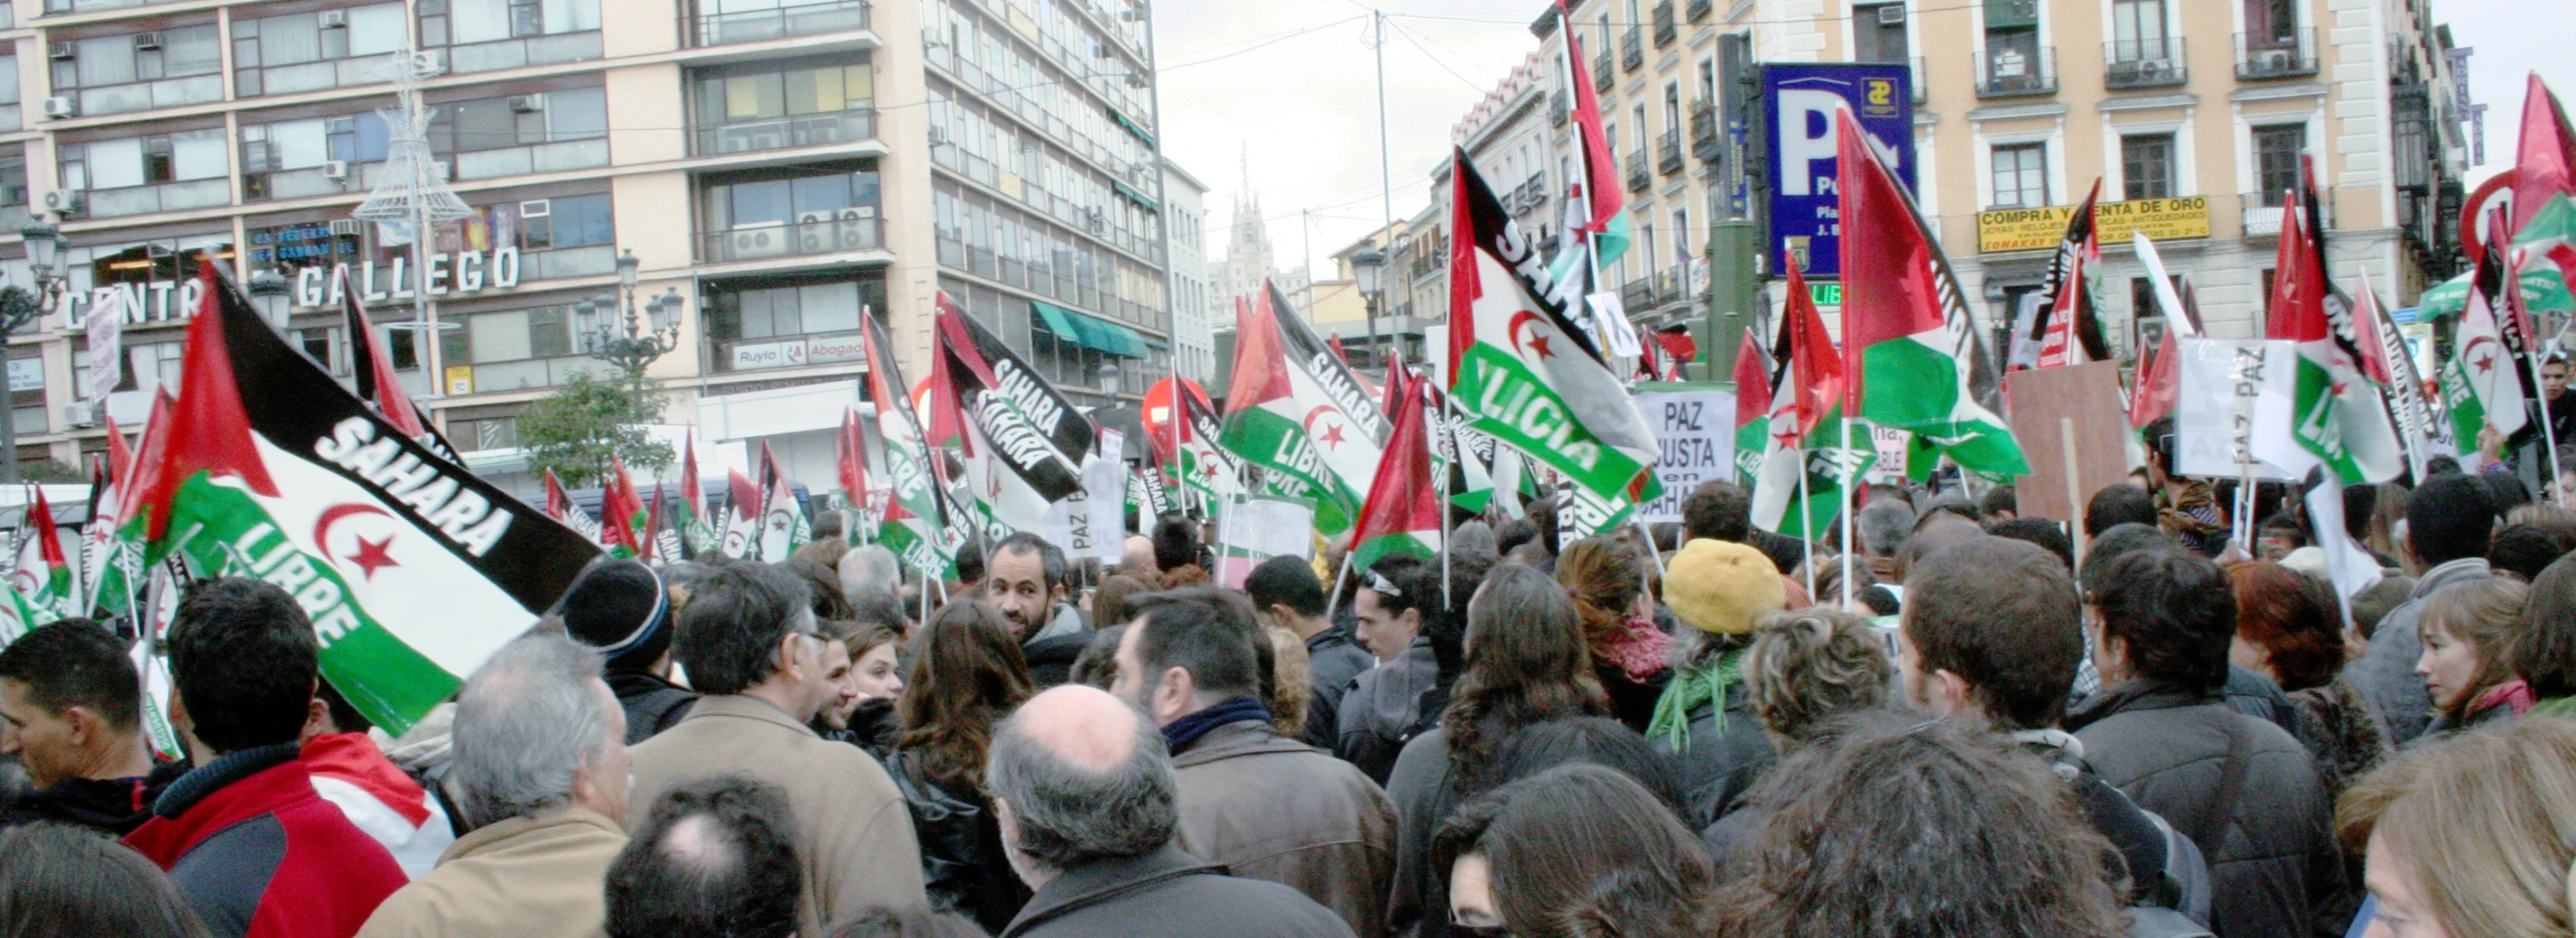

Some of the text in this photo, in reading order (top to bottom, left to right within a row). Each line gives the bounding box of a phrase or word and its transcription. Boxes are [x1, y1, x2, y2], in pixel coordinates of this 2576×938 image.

[1817, 207, 1839, 219] Pla
[1982, 197, 2205, 225] COMPRA Y ENTA DE ORO
[1984, 238, 2046, 250] SONAKAY
[65, 245, 519, 330] CNTR GALLEGO
[1812, 285, 1842, 305] LIB
[811, 343, 865, 357] Abogad
[994, 358, 1064, 437] SAHARA
[1309, 352, 1382, 440] SAHARA
[1476, 357, 1600, 471] LICIA
[1665, 401, 1703, 431] PAZ
[975, 389, 1053, 471] SAHARA
[1275, 428, 1335, 495] LIBRE
[1664, 472, 1699, 482] en
[314, 416, 515, 558] SAHARA
[1143, 467, 1168, 514] SAHARA
[1070, 513, 1092, 550] PAZ
[235, 522, 362, 650] LIBRE
